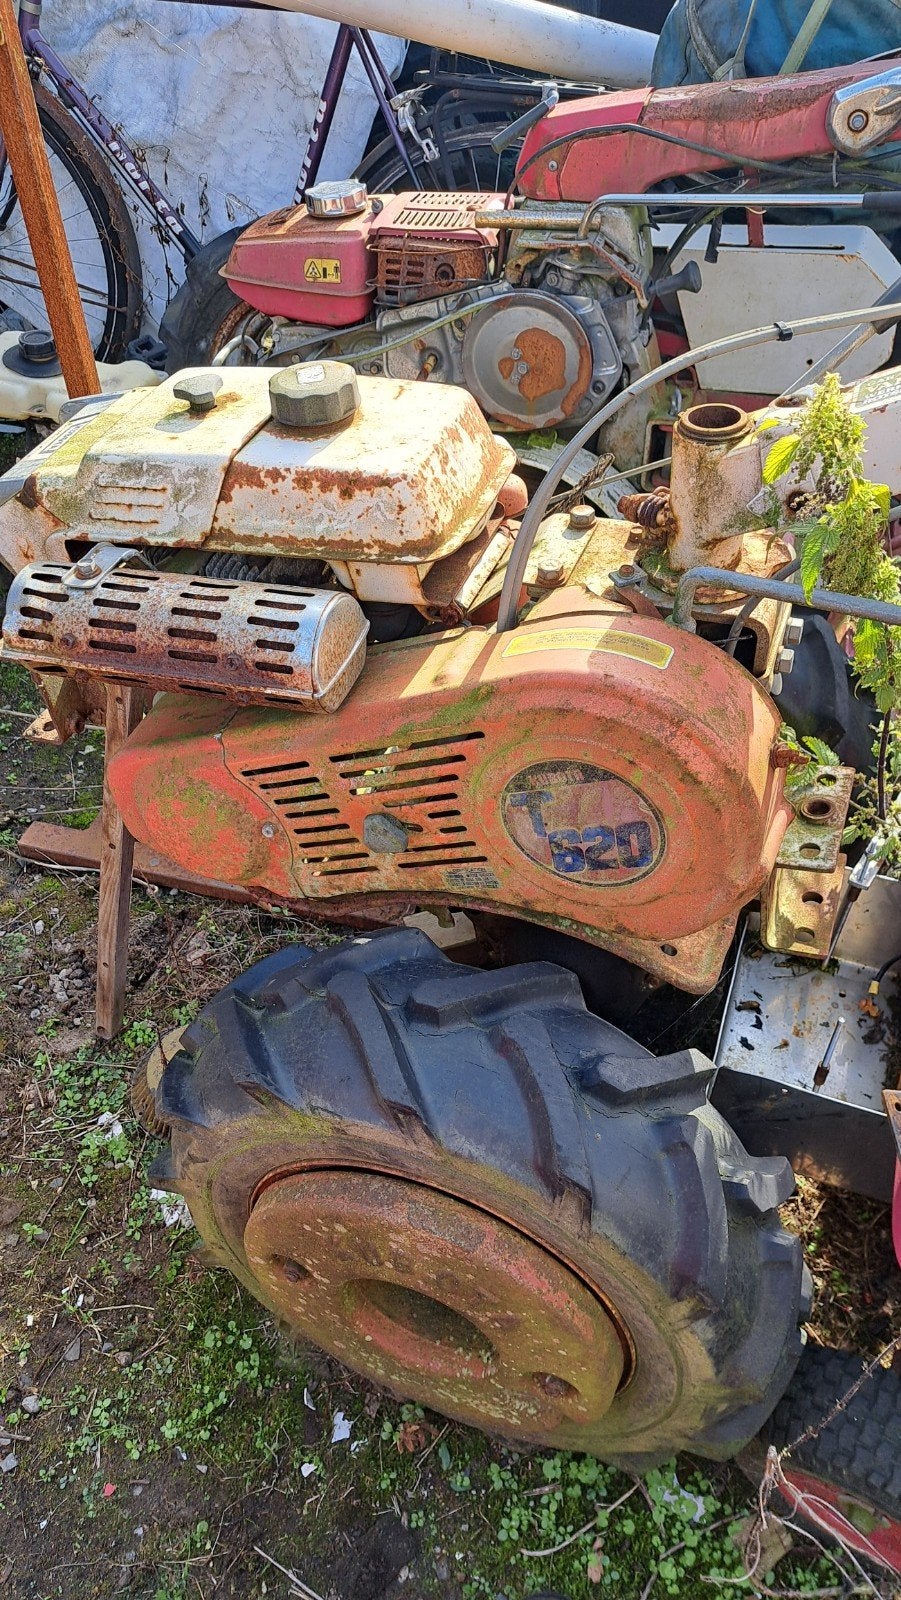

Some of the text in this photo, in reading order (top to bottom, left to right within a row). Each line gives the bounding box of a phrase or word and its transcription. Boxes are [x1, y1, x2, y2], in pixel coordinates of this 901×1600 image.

[108, 141, 184, 235] norta
[511, 793, 553, 836] T
[549, 822, 654, 873] 620
